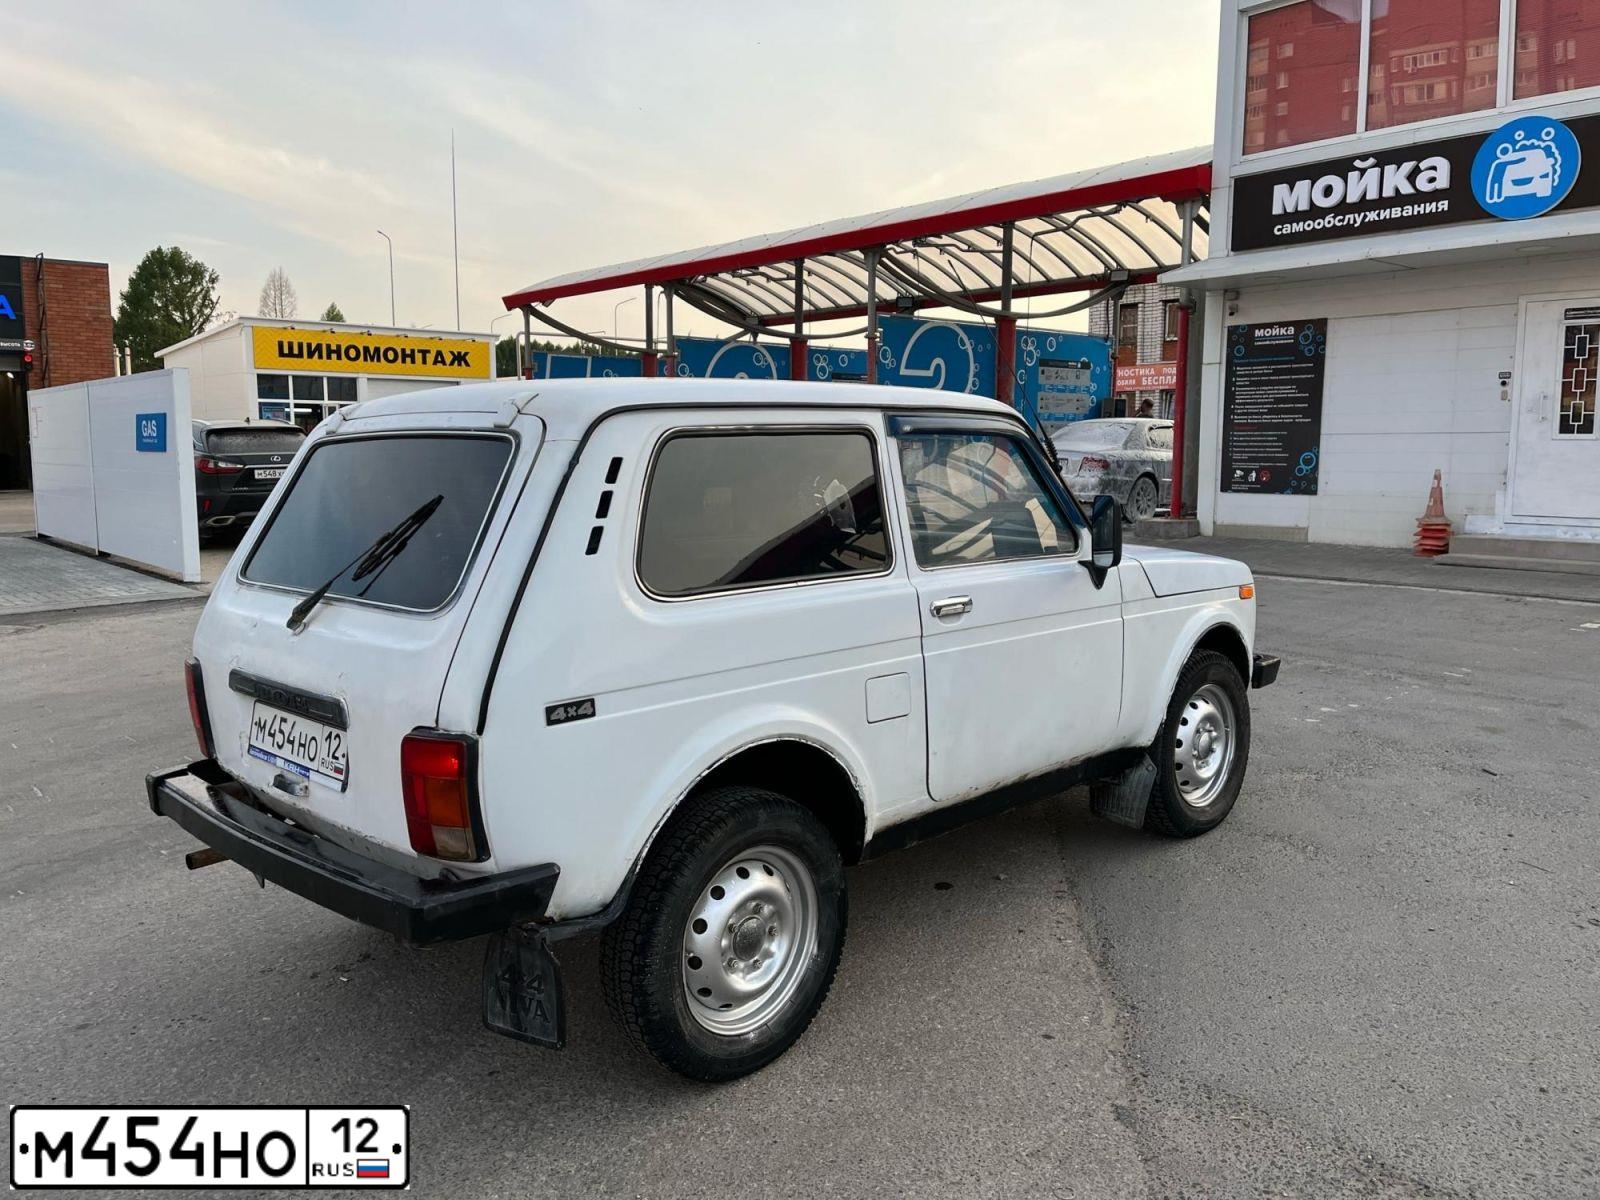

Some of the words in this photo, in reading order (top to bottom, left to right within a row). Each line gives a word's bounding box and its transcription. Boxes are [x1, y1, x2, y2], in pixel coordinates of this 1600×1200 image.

[1273, 199, 1449, 236] самообслуживания
[277, 340, 471, 368] ШИНОМОНТАЖ
[141, 420, 157, 437] GAS
[325, 731, 342, 761] 12
[320, 757, 335, 771] RUS
